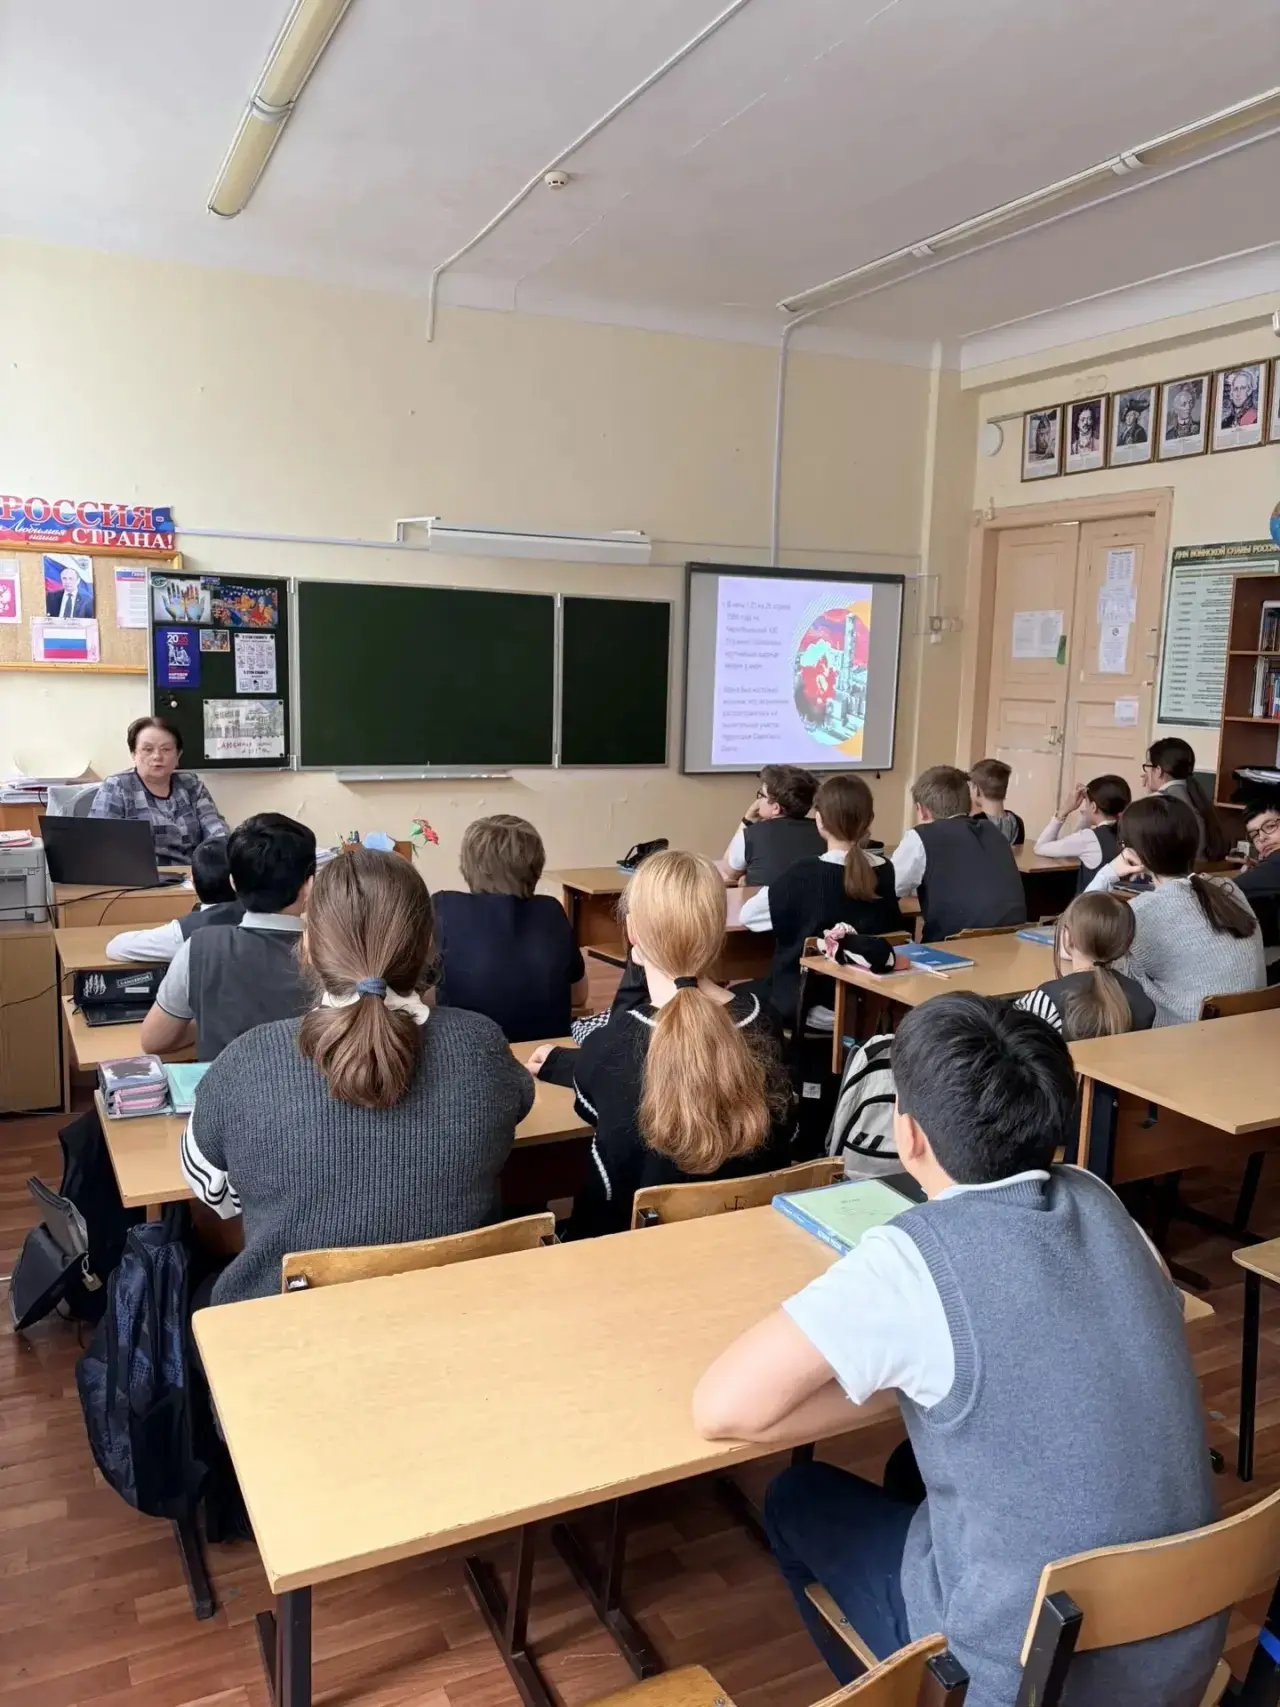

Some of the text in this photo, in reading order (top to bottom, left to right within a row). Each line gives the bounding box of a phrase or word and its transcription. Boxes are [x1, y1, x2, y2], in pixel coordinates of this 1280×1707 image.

[8, 517, 67, 536] Любимая
[28, 534, 60, 542] наша
[72, 528, 174, 550] СТРАНА!
[1174, 549, 1190, 560] ДНИ
[1190, 545, 1226, 558] ВОИНСКОЙ
[1226, 545, 1251, 555] СЛАВЫ
